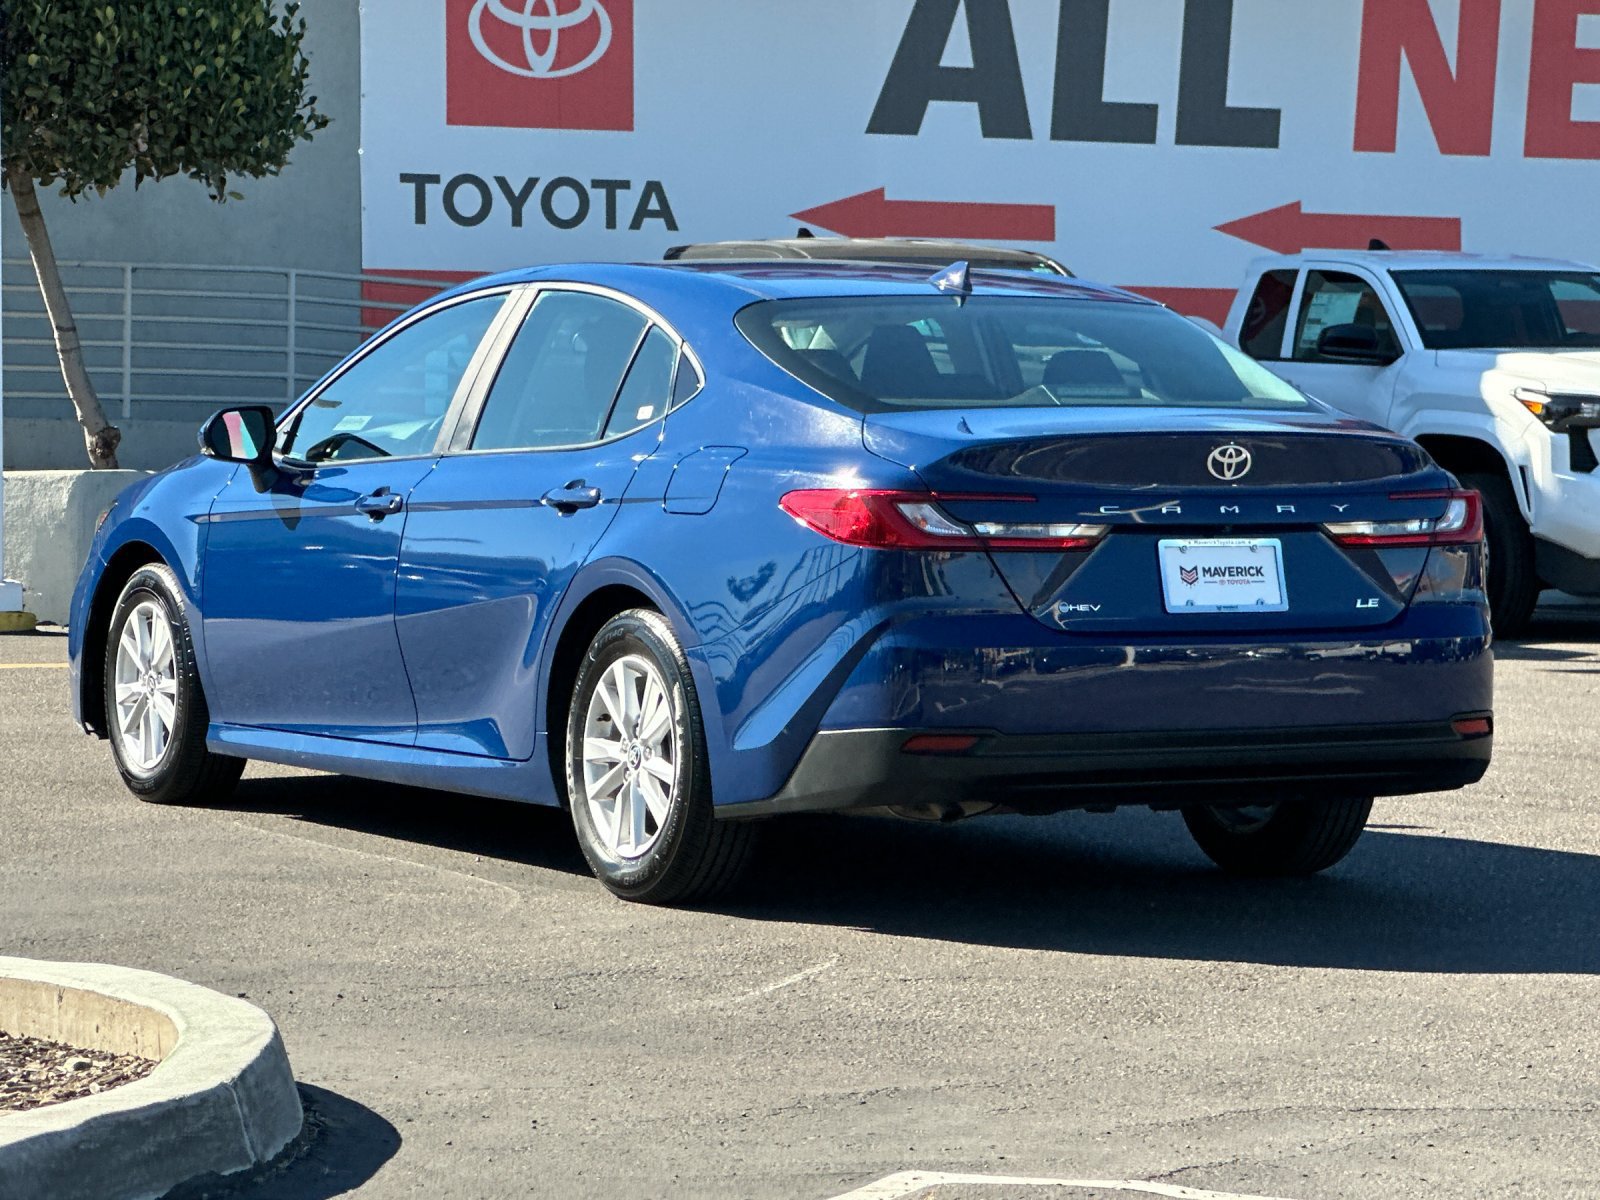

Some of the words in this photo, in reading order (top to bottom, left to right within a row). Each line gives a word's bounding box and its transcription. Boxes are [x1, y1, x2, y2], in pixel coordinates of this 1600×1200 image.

[865, 0, 1282, 149] ALL
[1353, 0, 1600, 160] NE
[400, 172, 679, 232] TOYOTA
[1099, 504, 1350, 514] CAMRY
[1202, 566, 1264, 578] MAVERICK
[1069, 604, 1101, 612] HEV
[1355, 598, 1380, 608] LE
